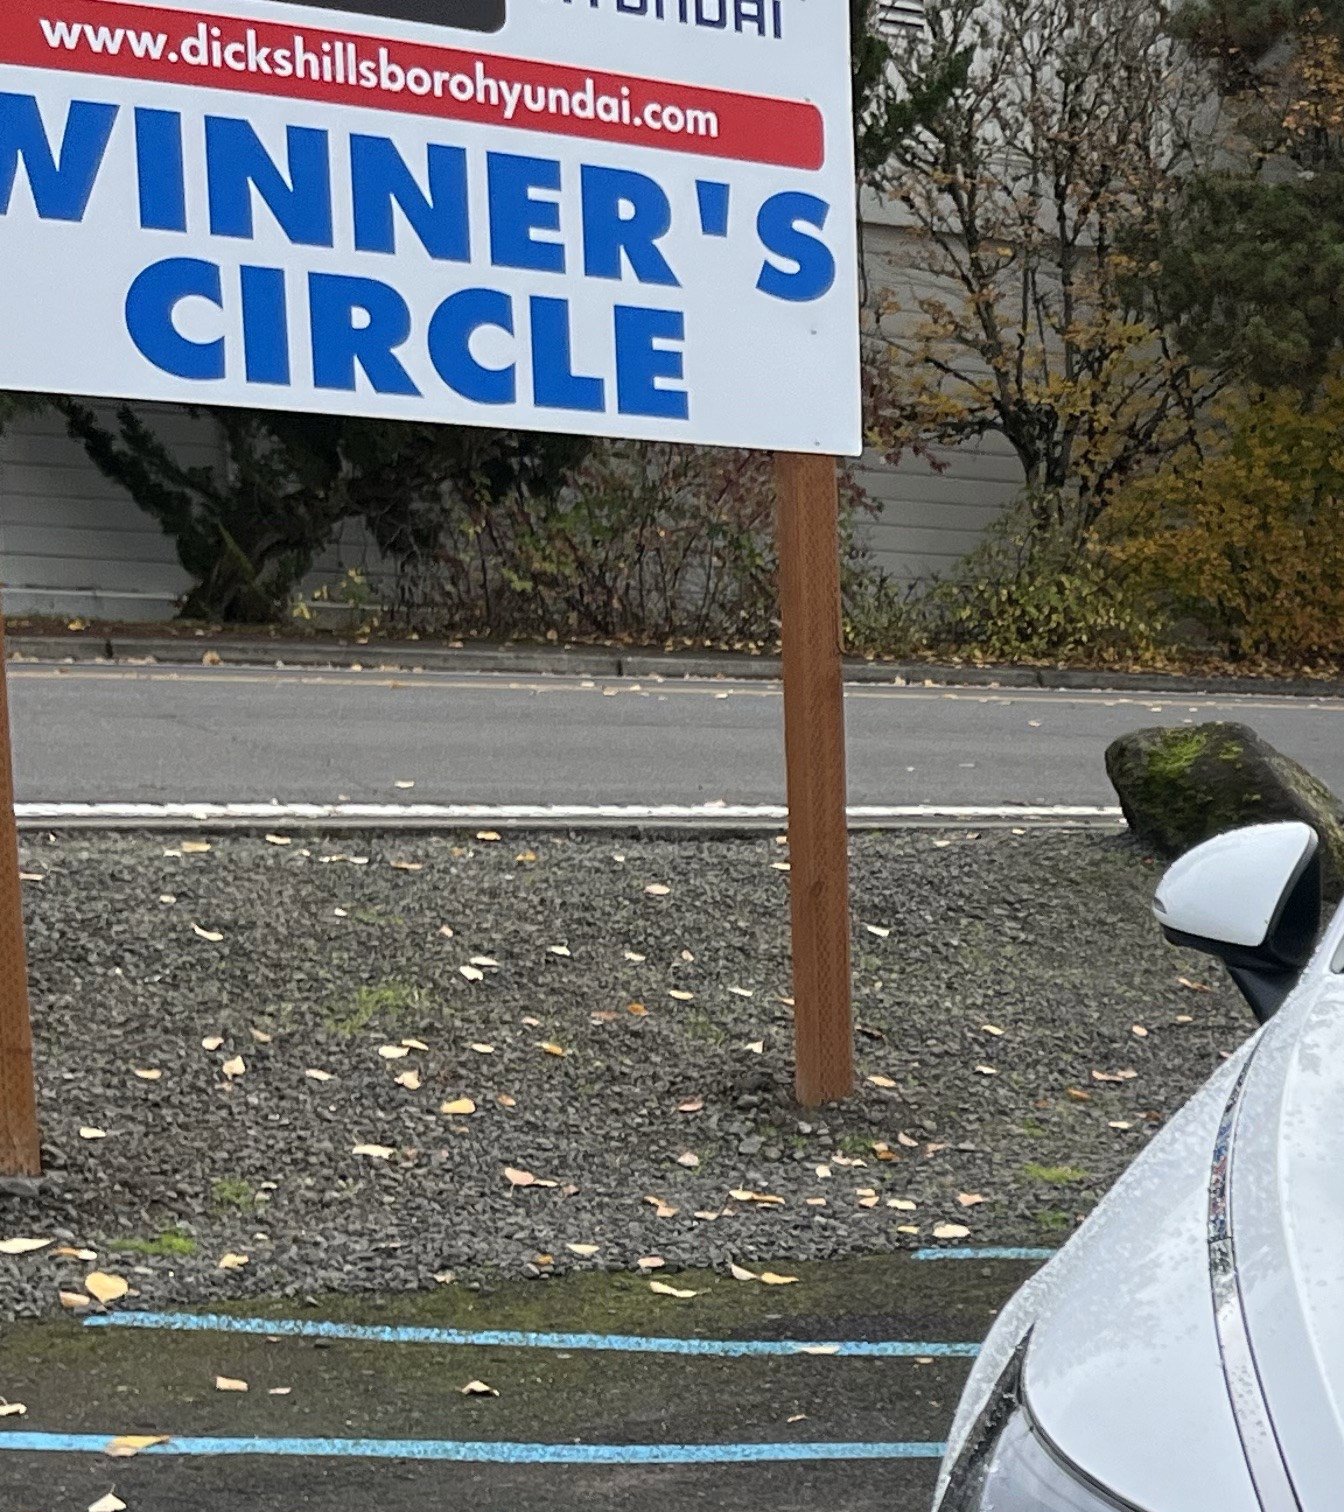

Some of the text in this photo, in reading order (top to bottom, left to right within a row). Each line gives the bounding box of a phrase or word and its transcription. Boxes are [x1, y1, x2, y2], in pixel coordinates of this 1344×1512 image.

[40, 18, 719, 139] www.dickshillsborohyundai.com
[564, 0, 782, 39] NDAI
[0, 91, 836, 303] WINNER'S
[124, 256, 690, 421] CIRCLE
